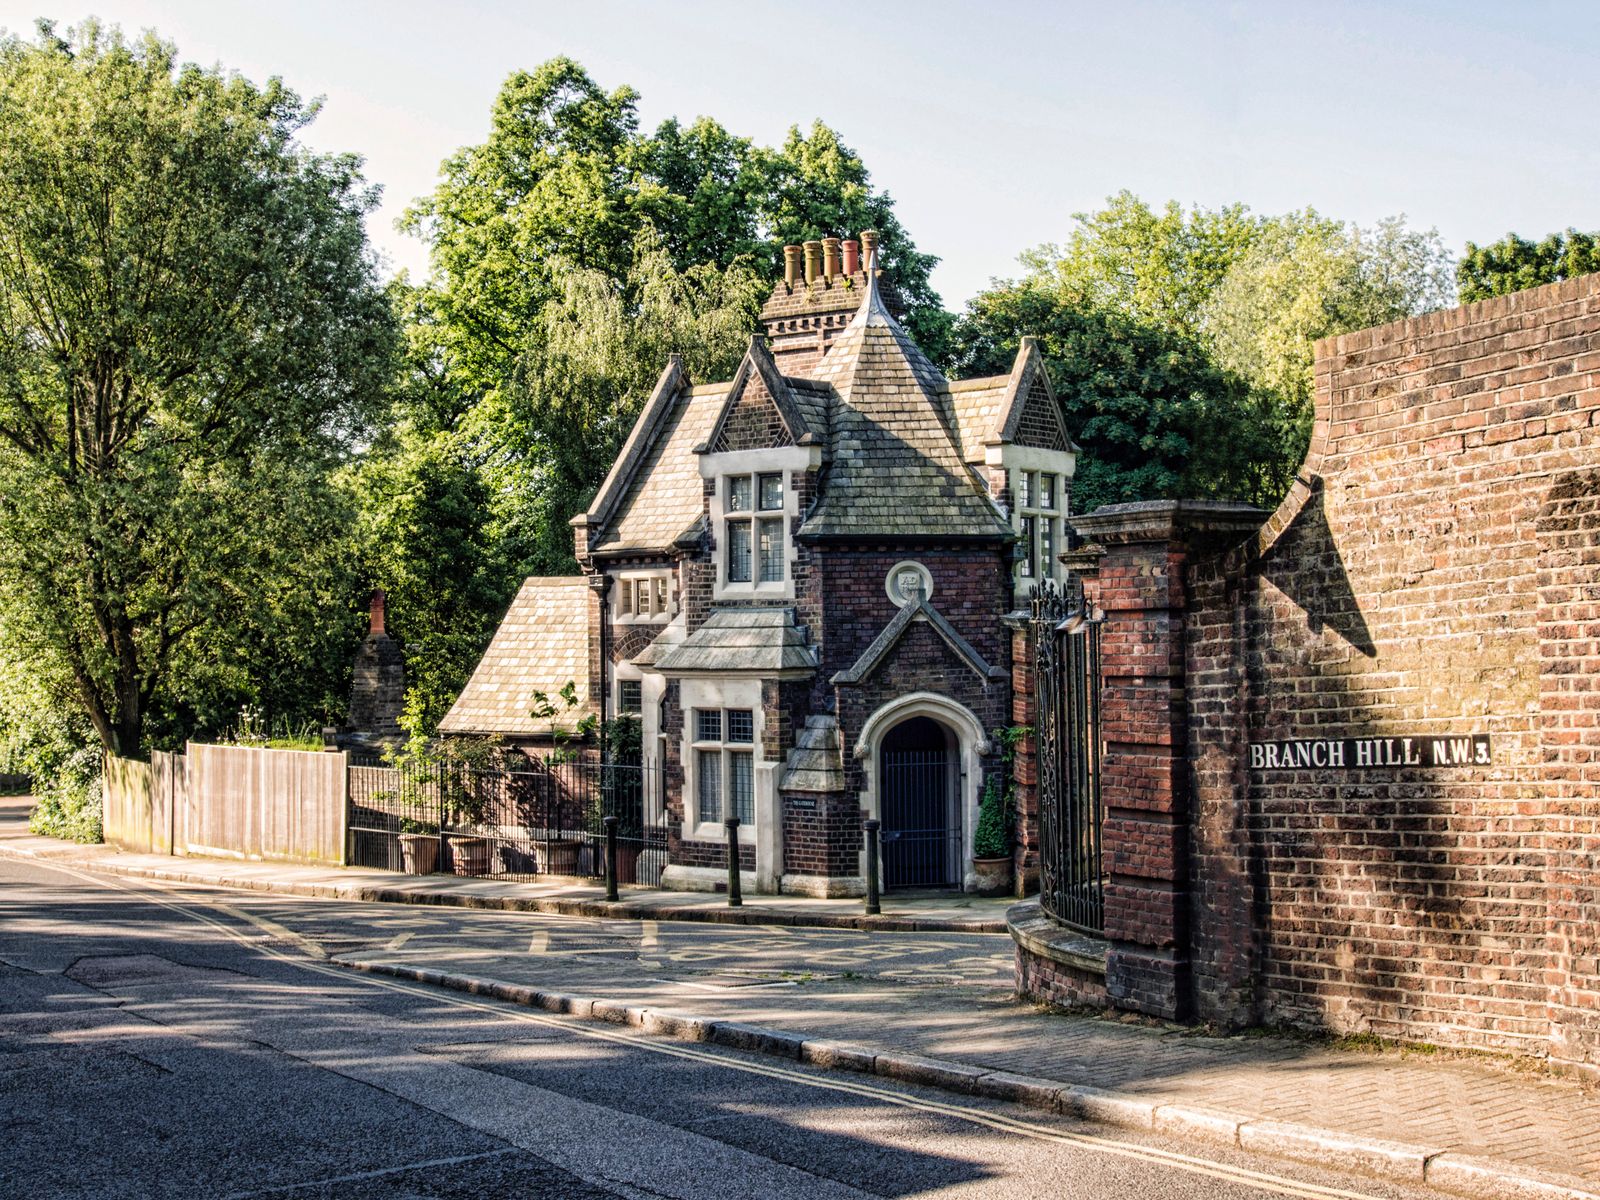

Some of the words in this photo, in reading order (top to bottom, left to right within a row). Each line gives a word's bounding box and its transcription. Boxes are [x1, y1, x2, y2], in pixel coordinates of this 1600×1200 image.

[1250, 740, 1345, 769] BRANCH
[1356, 738, 1420, 767] HILL
[804, 940, 980, 966] KEEP
